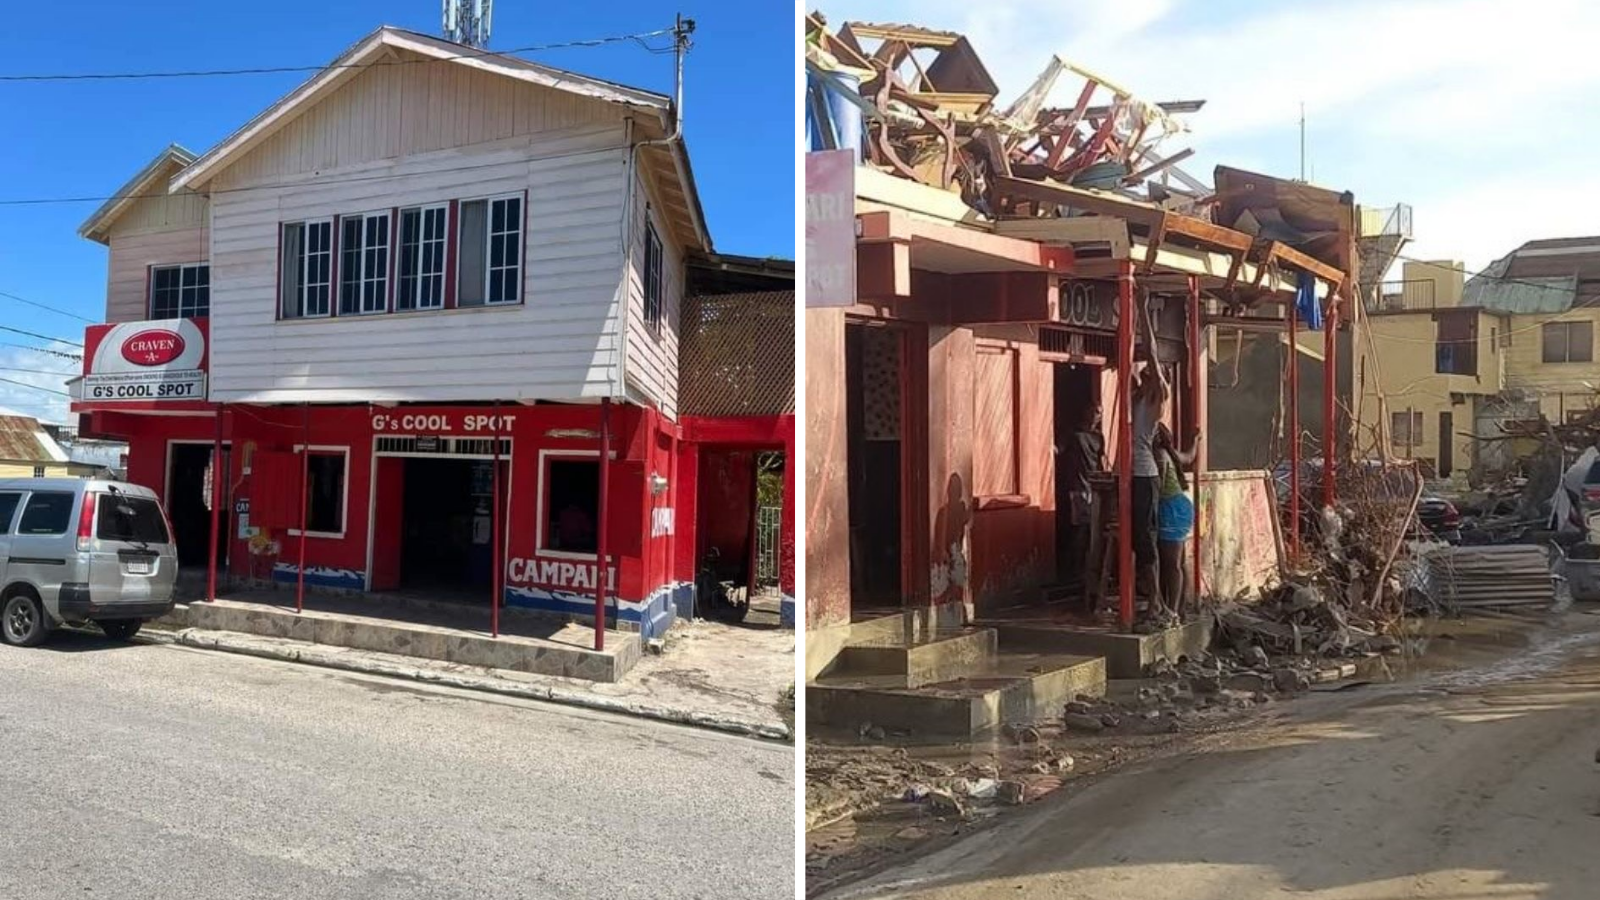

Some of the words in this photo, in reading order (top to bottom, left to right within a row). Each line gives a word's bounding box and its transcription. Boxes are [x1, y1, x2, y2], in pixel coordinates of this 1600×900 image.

[130, 339, 175, 351] CRAVEN
[93, 386, 114, 398] G'S
[117, 385, 154, 397] COOL
[157, 383, 194, 396] SPOT
[372, 415, 399, 430] G's
[402, 414, 452, 430] COOL
[463, 415, 516, 431] SPOT
